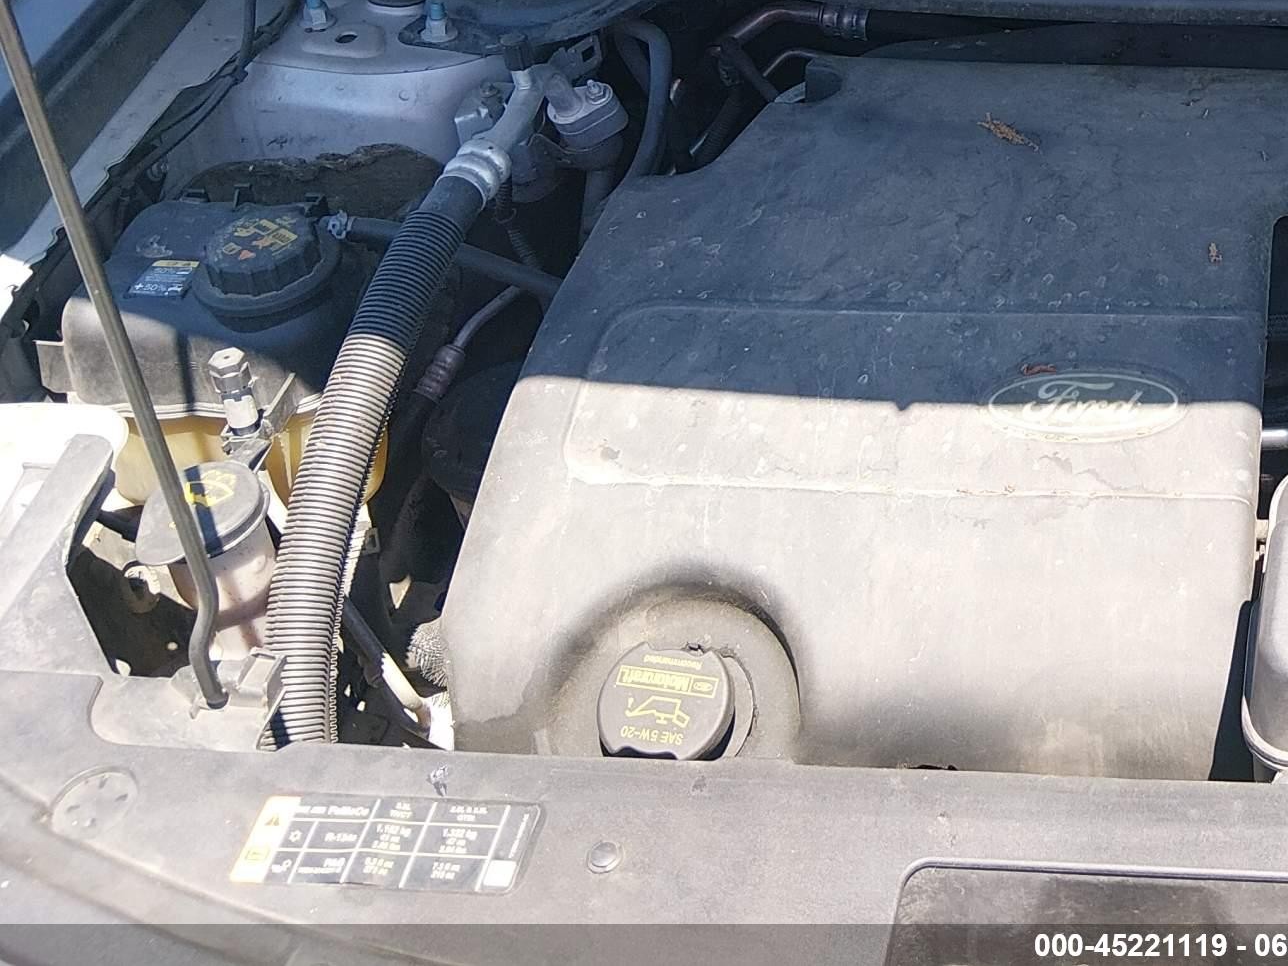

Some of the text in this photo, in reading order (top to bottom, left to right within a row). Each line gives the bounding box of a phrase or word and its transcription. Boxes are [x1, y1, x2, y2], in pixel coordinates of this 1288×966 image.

[1021, 378, 1145, 420] Ford
[643, 654, 703, 670] Recommended
[621, 668, 690, 692] Motorcraft
[620, 725, 685, 746] SAE 5W-20
